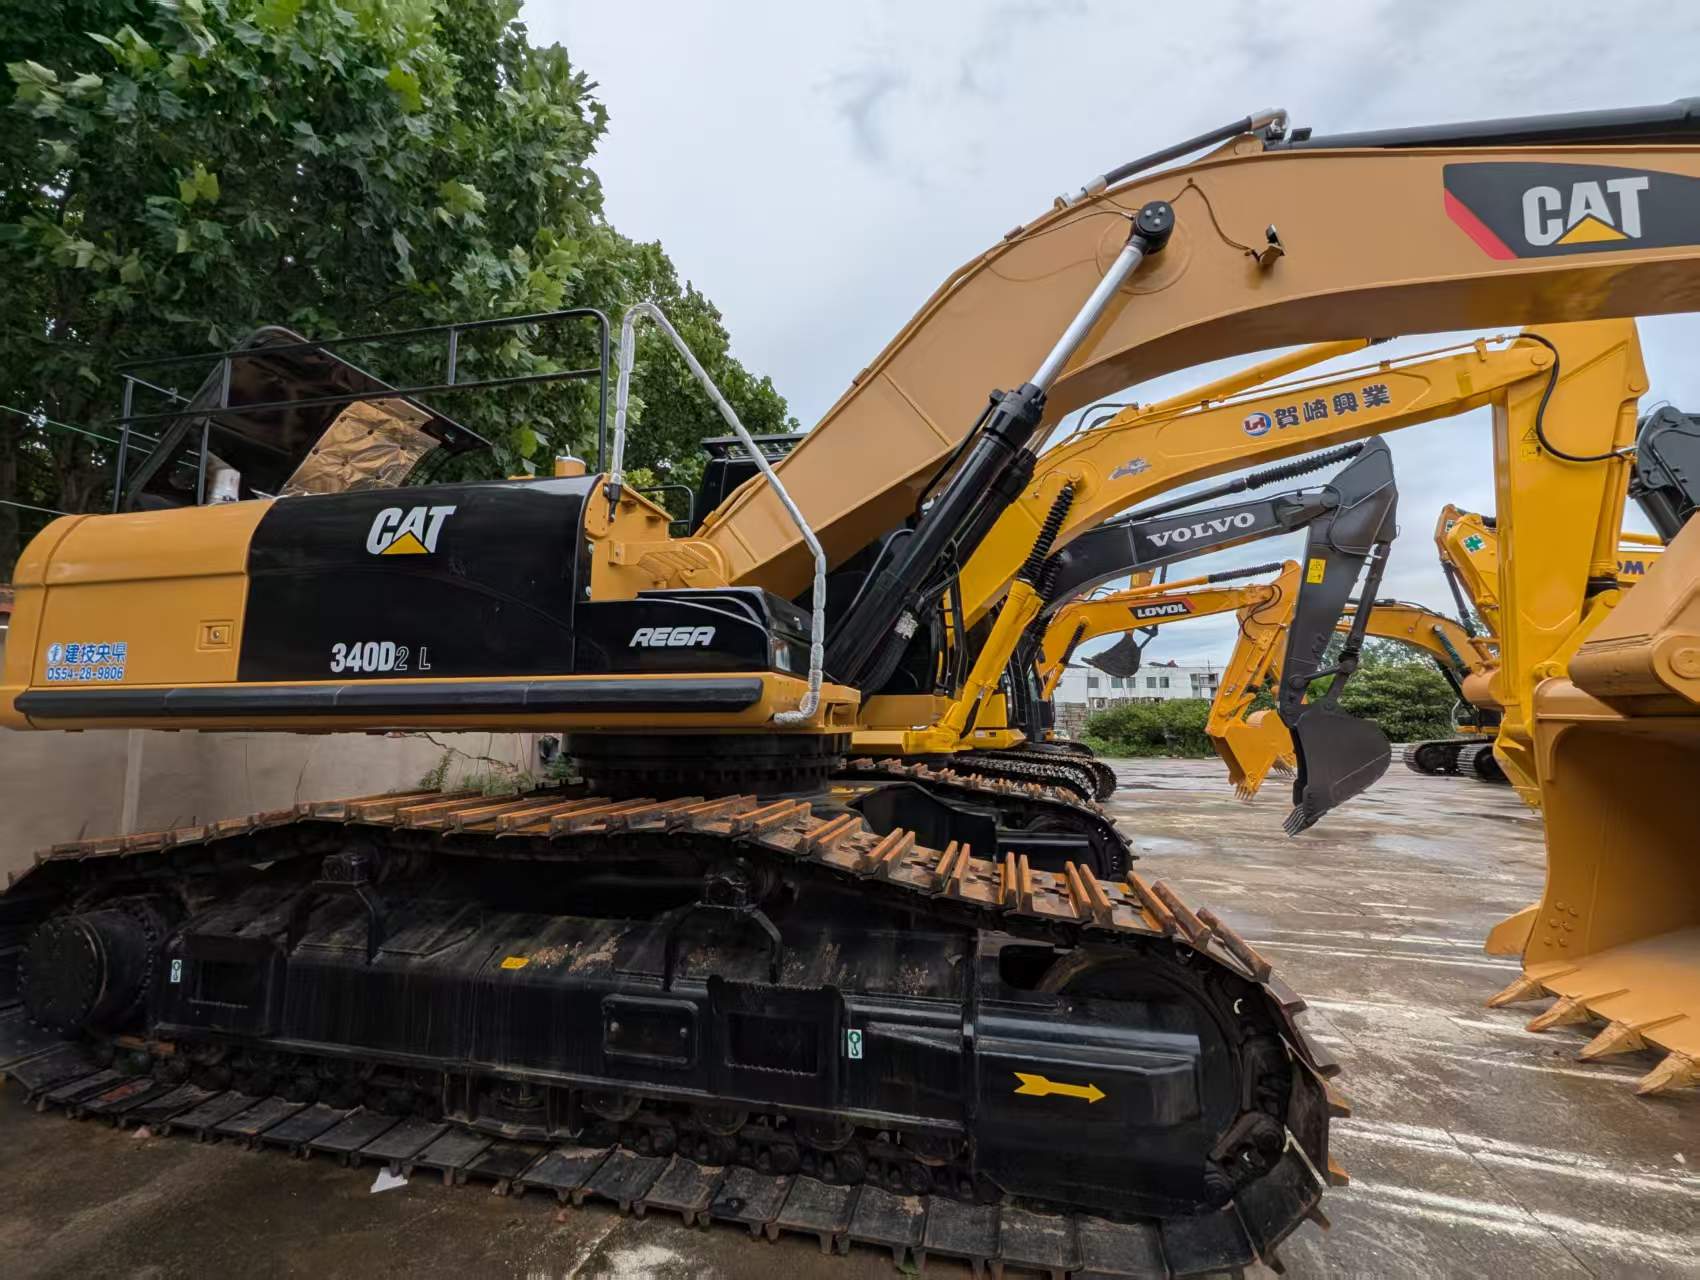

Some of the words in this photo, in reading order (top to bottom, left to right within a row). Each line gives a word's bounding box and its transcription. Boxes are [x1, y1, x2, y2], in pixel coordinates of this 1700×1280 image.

[1522, 176, 1649, 246] CAT
[366, 505, 457, 555] CAT
[1146, 512, 1256, 548] VOLVO
[1137, 603, 1187, 618] LOVOL
